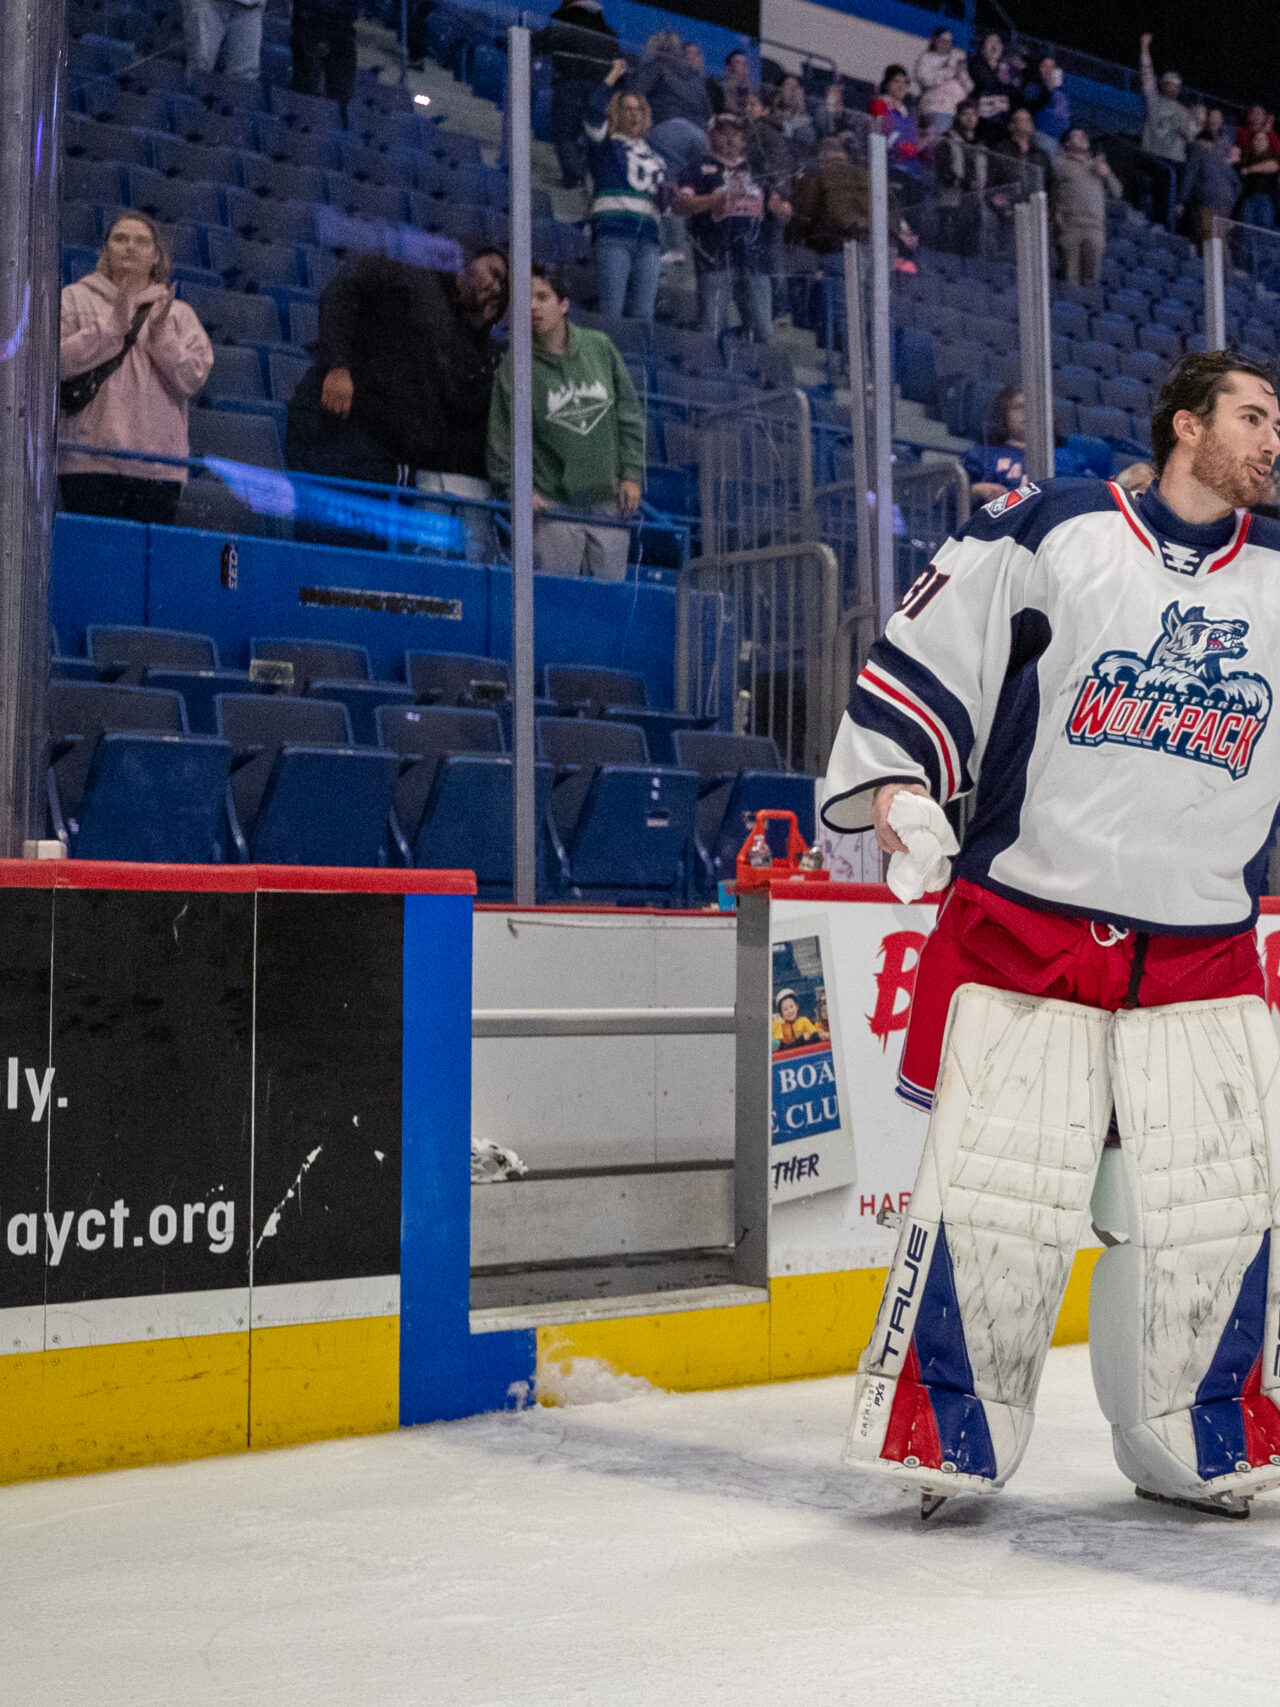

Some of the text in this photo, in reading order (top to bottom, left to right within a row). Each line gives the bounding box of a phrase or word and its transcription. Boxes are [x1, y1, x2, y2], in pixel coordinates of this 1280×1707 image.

[1132, 689, 1244, 711] HARTFORD
[7, 1199, 235, 1267] ayct.org
[879, 1223, 928, 1368] TRUE
